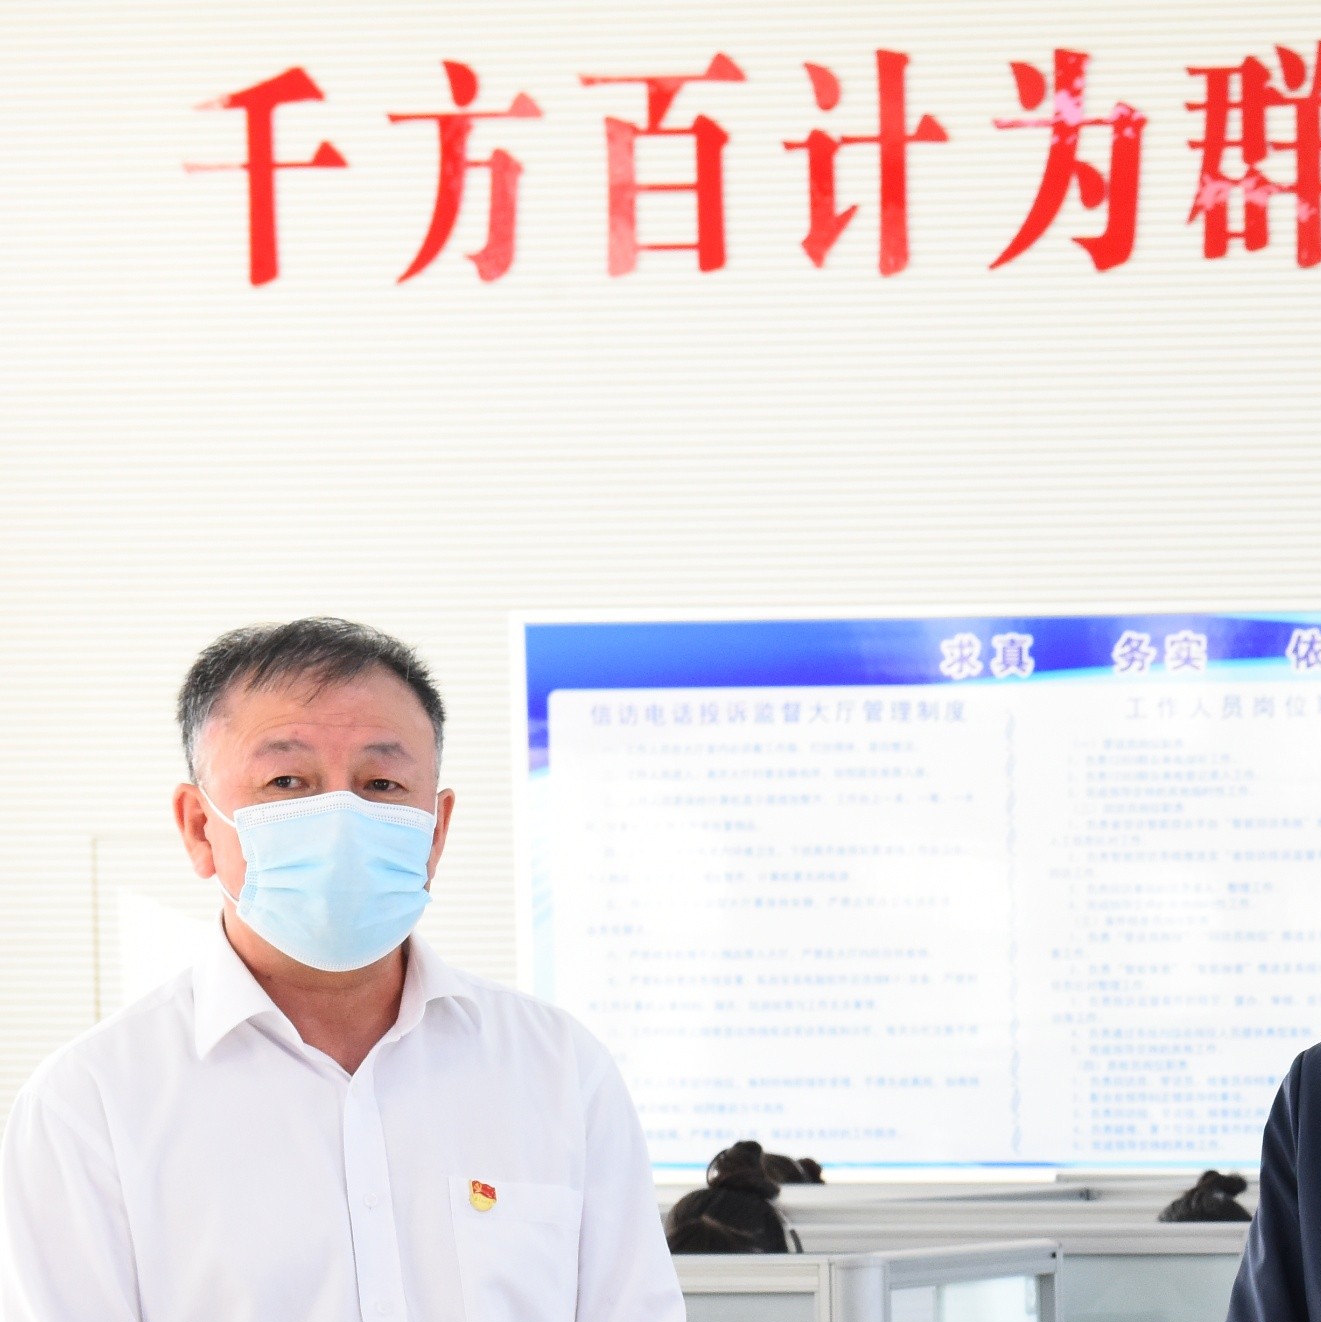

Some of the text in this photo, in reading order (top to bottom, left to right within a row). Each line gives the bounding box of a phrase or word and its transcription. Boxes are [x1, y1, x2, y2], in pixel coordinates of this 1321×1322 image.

[940, 633, 1034, 680] 求真
[1113, 630, 1208, 675] 务实
[591, 699, 968, 727] 信访电话投诉监督大厅管理制度
